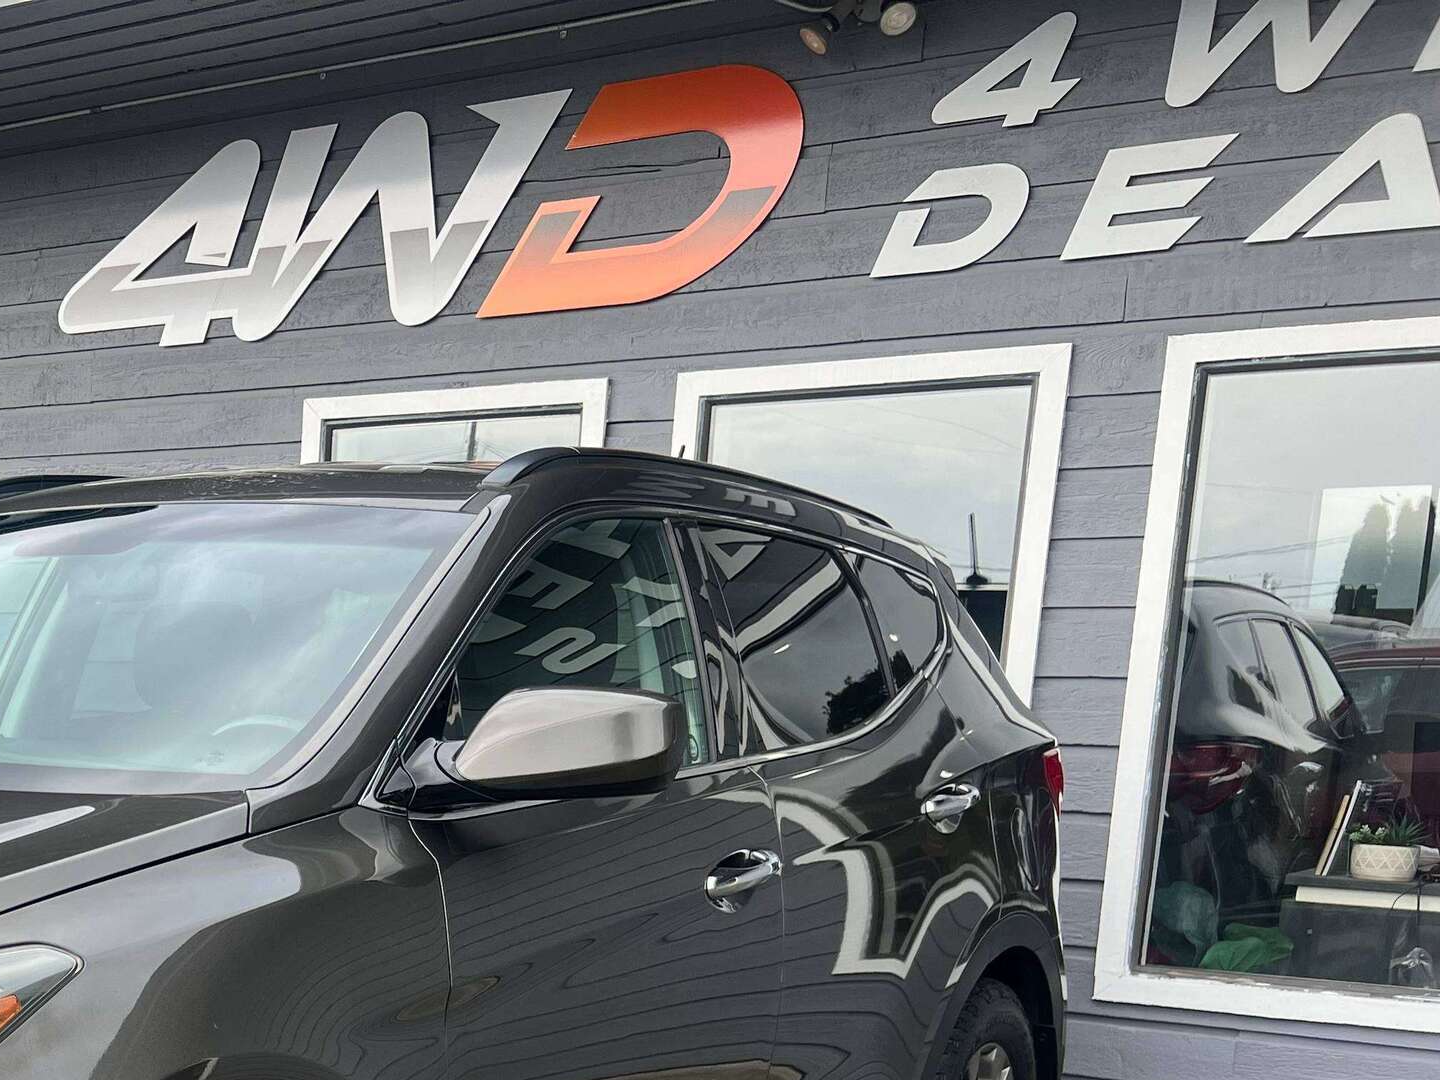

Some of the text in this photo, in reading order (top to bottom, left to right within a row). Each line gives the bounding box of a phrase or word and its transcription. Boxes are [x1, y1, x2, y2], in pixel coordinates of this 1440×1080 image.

[931, 0, 1440, 128] 4 W
[58, 64, 804, 347] 4WD
[869, 112, 1440, 279] DEA
